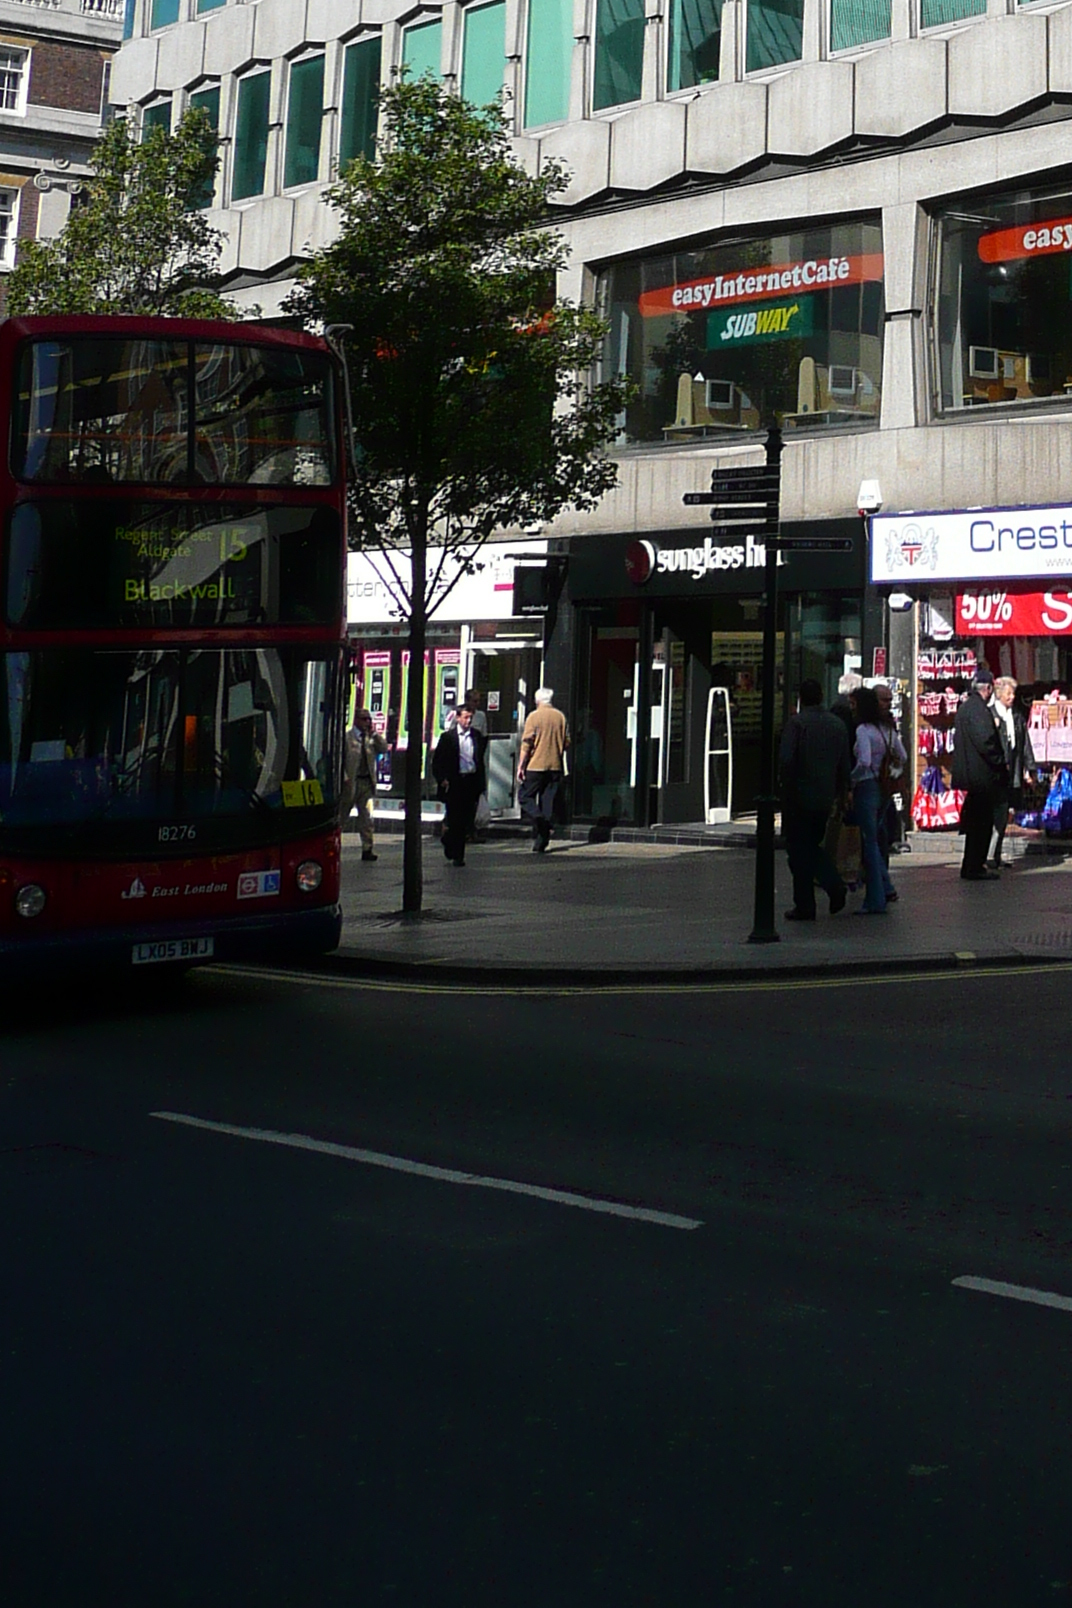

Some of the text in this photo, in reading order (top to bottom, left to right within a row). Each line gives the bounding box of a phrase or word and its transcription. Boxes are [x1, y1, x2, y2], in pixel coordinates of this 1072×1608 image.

[672, 257, 851, 307] easyInternetCafé
[720, 304, 799, 342] SUBWAY
[114, 527, 213, 545] Regent Street
[219, 528, 248, 562] 15
[137, 543, 192, 561] Aldgate
[656, 536, 745, 581] sunglass
[124, 577, 236, 602] Blackwall
[960, 587, 1014, 622] 50%
[301, 783, 316, 807] 16
[158, 824, 198, 842] 18276
[151, 882, 229, 898] East London
[137, 942, 177, 961] LX05
